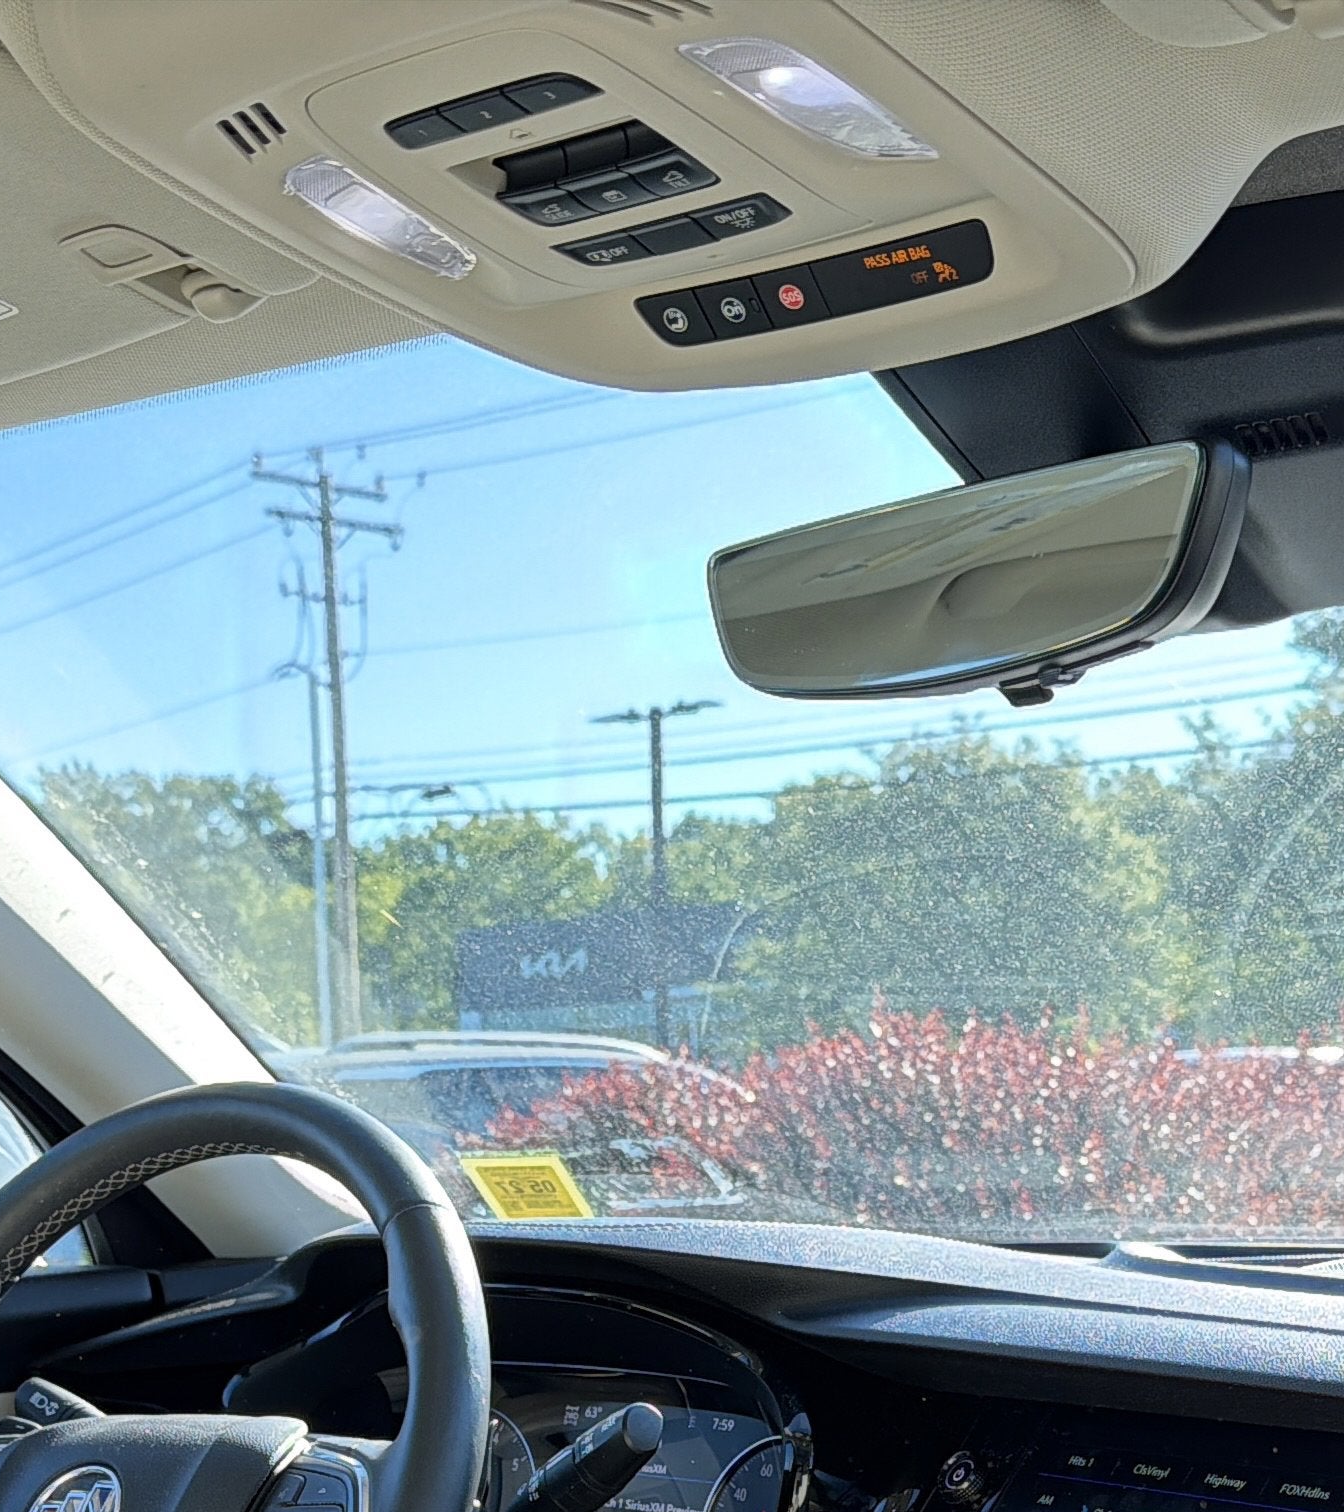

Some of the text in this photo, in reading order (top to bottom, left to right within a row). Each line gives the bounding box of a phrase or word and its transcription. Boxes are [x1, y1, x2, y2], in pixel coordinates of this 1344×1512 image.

[713, 206, 756, 224] ON/OFF
[863, 244, 932, 270] PASS AIR BAG
[911, 270, 929, 285] OFF
[782, 290, 802, 305] SOS
[585, 1405, 603, 1419] 63°
[712, 1417, 736, 1432] 7:59
[1068, 1455, 1087, 1467] Hits
[759, 1463, 773, 1478] 60
[1133, 1463, 1171, 1481] ClsVinyl
[1204, 1473, 1247, 1491] Highway
[733, 1487, 747, 1502] 40
[1279, 1483, 1330, 1500] FOXHdlns
[1037, 1494, 1055, 1505] AM
